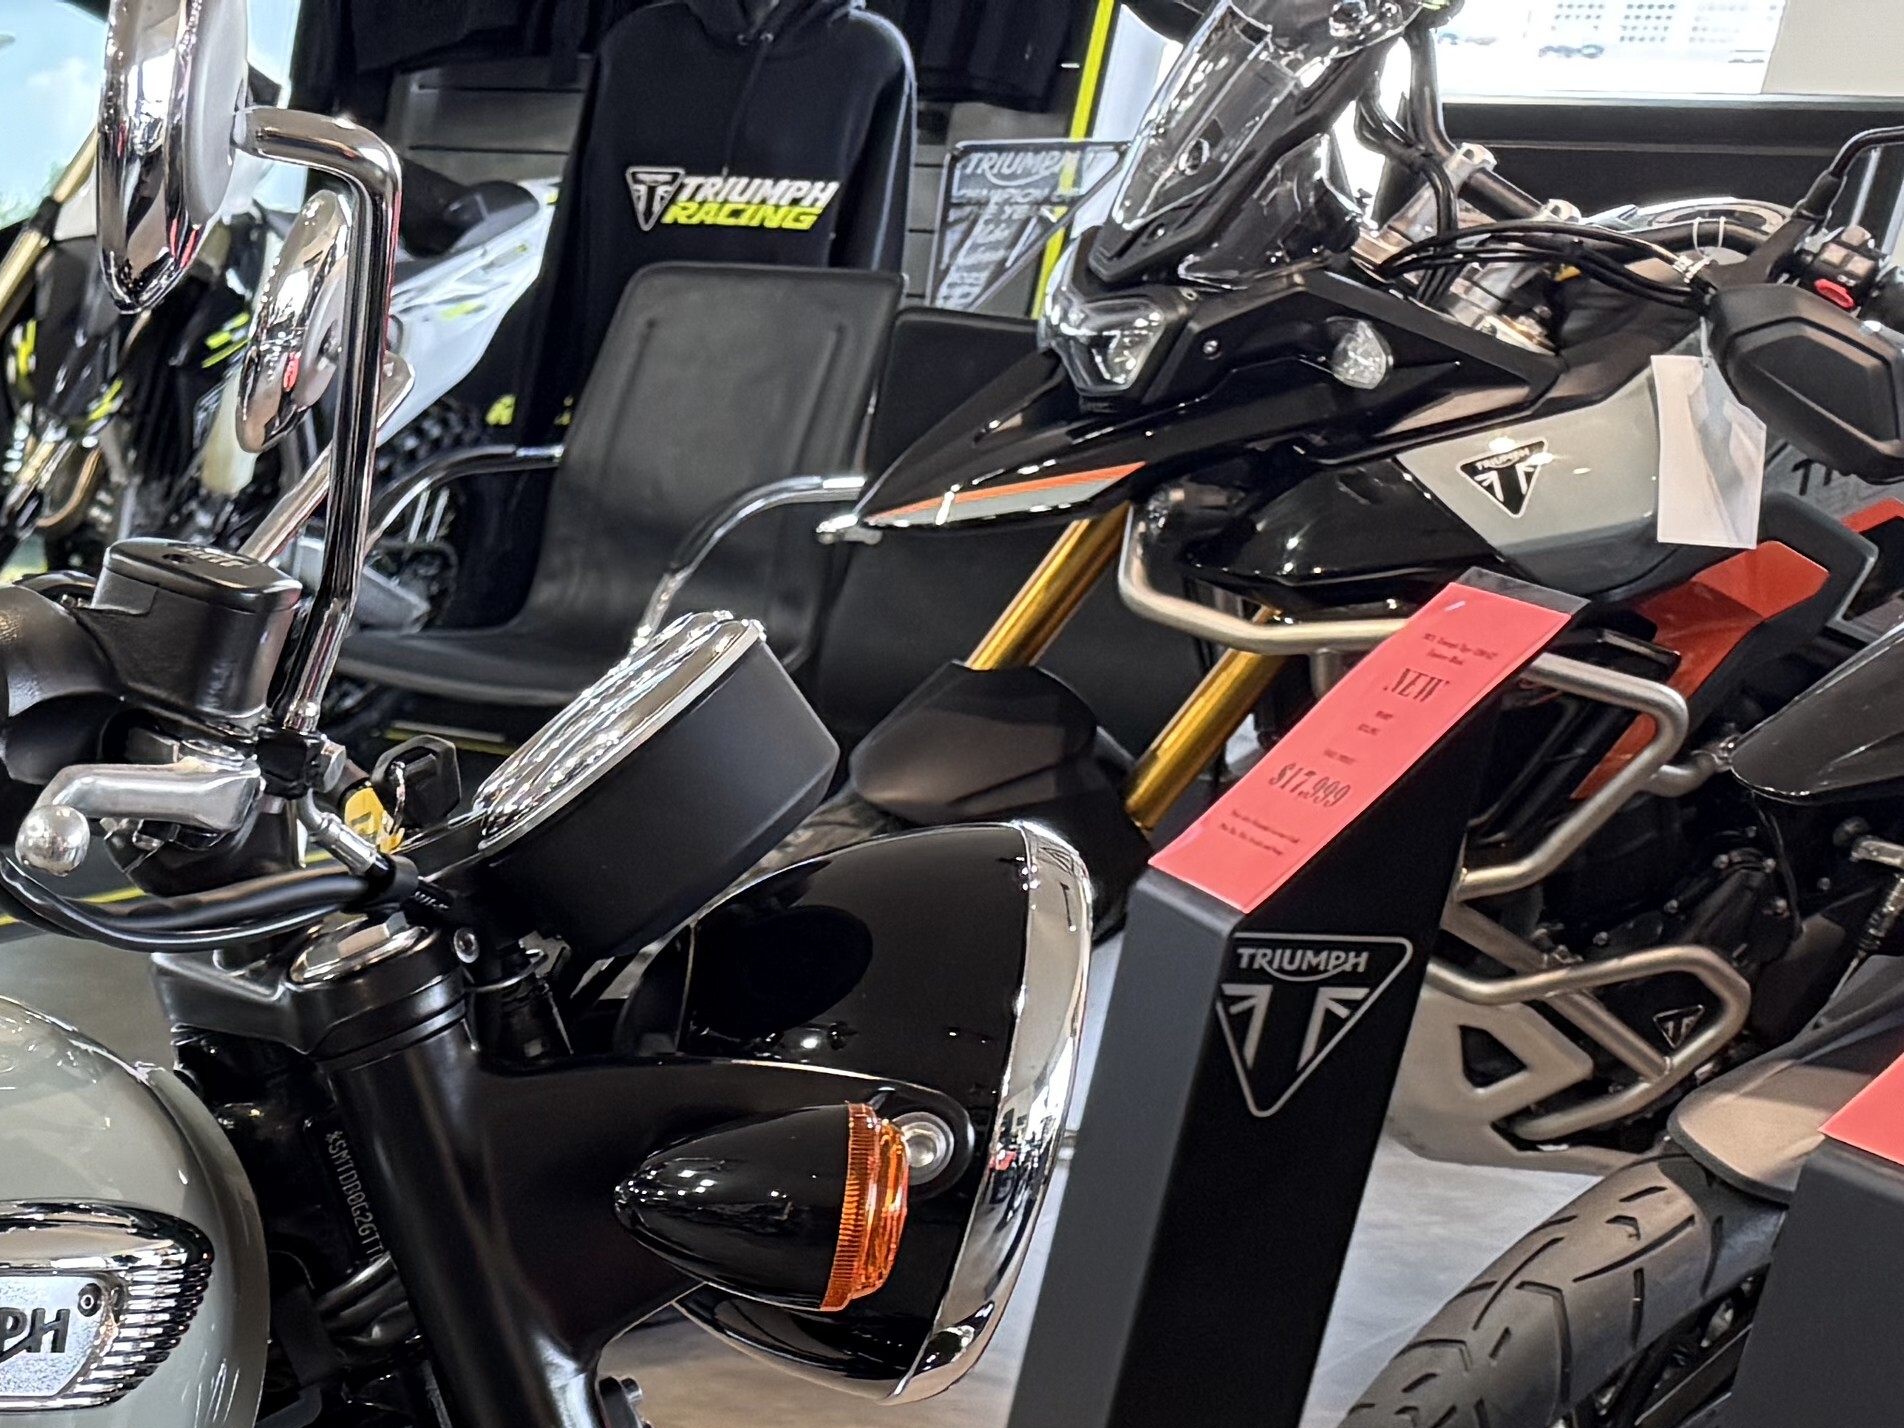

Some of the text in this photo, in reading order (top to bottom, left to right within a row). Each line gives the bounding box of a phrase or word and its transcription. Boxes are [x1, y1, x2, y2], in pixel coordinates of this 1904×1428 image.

[676, 176, 840, 209] TRIUMPH
[660, 202, 824, 230] RACING
[1383, 667, 1450, 702] NEW
[1237, 948, 1369, 982] TRIUMPH
